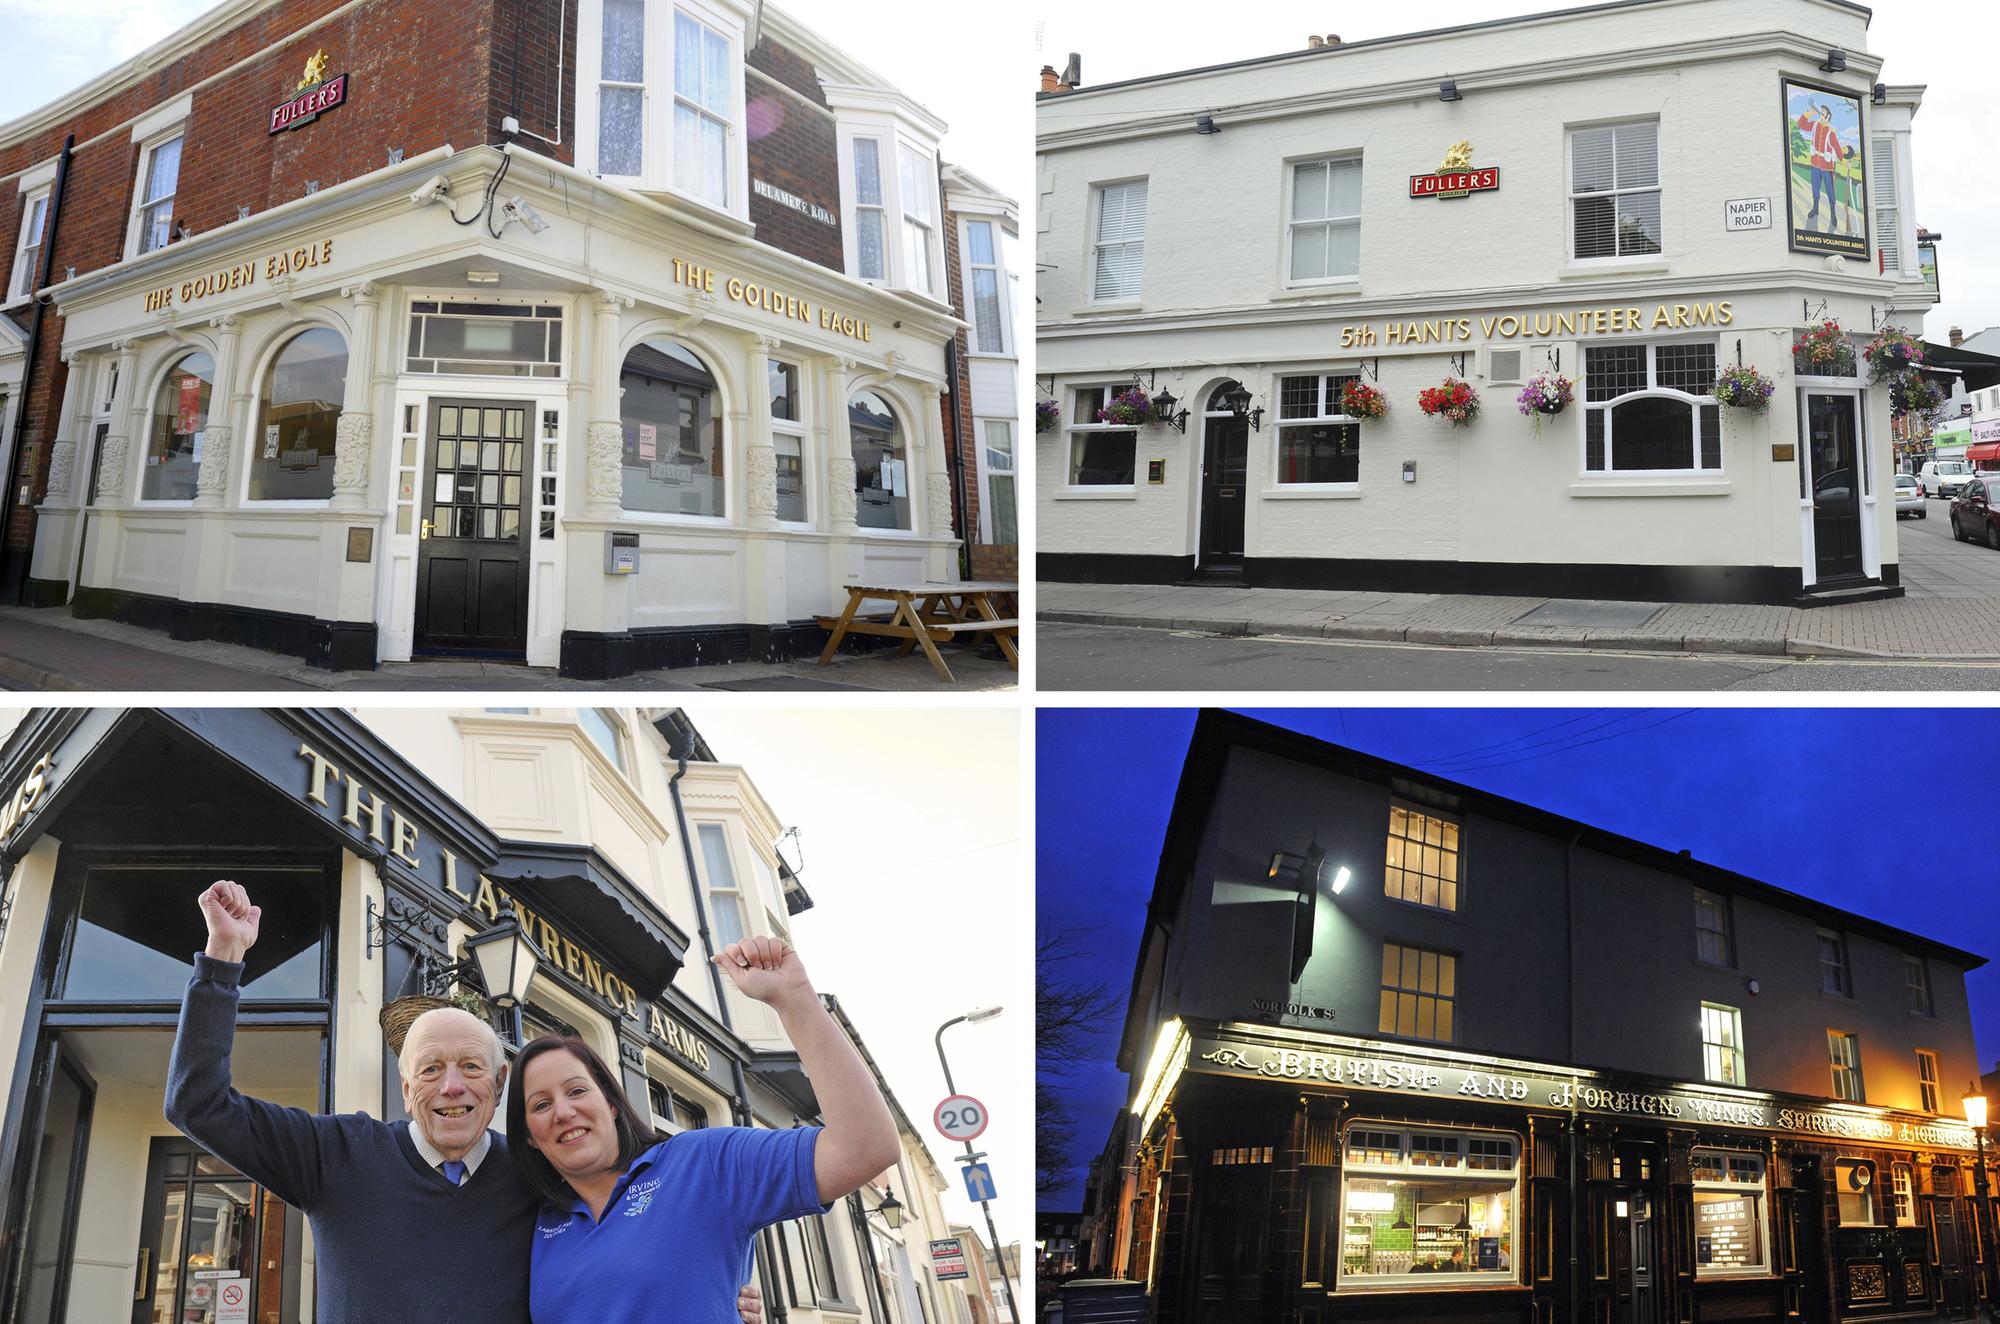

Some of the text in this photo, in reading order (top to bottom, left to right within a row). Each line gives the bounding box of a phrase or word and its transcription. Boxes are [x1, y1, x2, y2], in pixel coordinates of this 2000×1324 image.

[272, 84, 337, 127] FULLER'S
[753, 178, 836, 226] DELAMERE ROAD
[1414, 171, 1491, 192] FULLER'S
[1730, 202, 1767, 214] NAPIER
[1735, 215, 1762, 226] ROAD
[1805, 236, 1822, 244] HANTS
[1822, 239, 1851, 248] VOLUNTEER
[143, 239, 332, 312] THE GOLDEN EAGLE
[672, 257, 872, 342] THE GOLDEN EAGLE
[1340, 301, 1733, 347] 5th HANTS VOLUNTEER ARMS
[299, 743, 421, 870] THE
[649, 1003, 710, 1072] ARMS
[1250, 999, 1317, 1018] NORFOLK
[1259, 1048, 1441, 1089] BRITISH
[1458, 1070, 1530, 1100] AND
[1549, 1081, 1682, 1118] FOREIGN
[941, 1106, 980, 1130] 20
